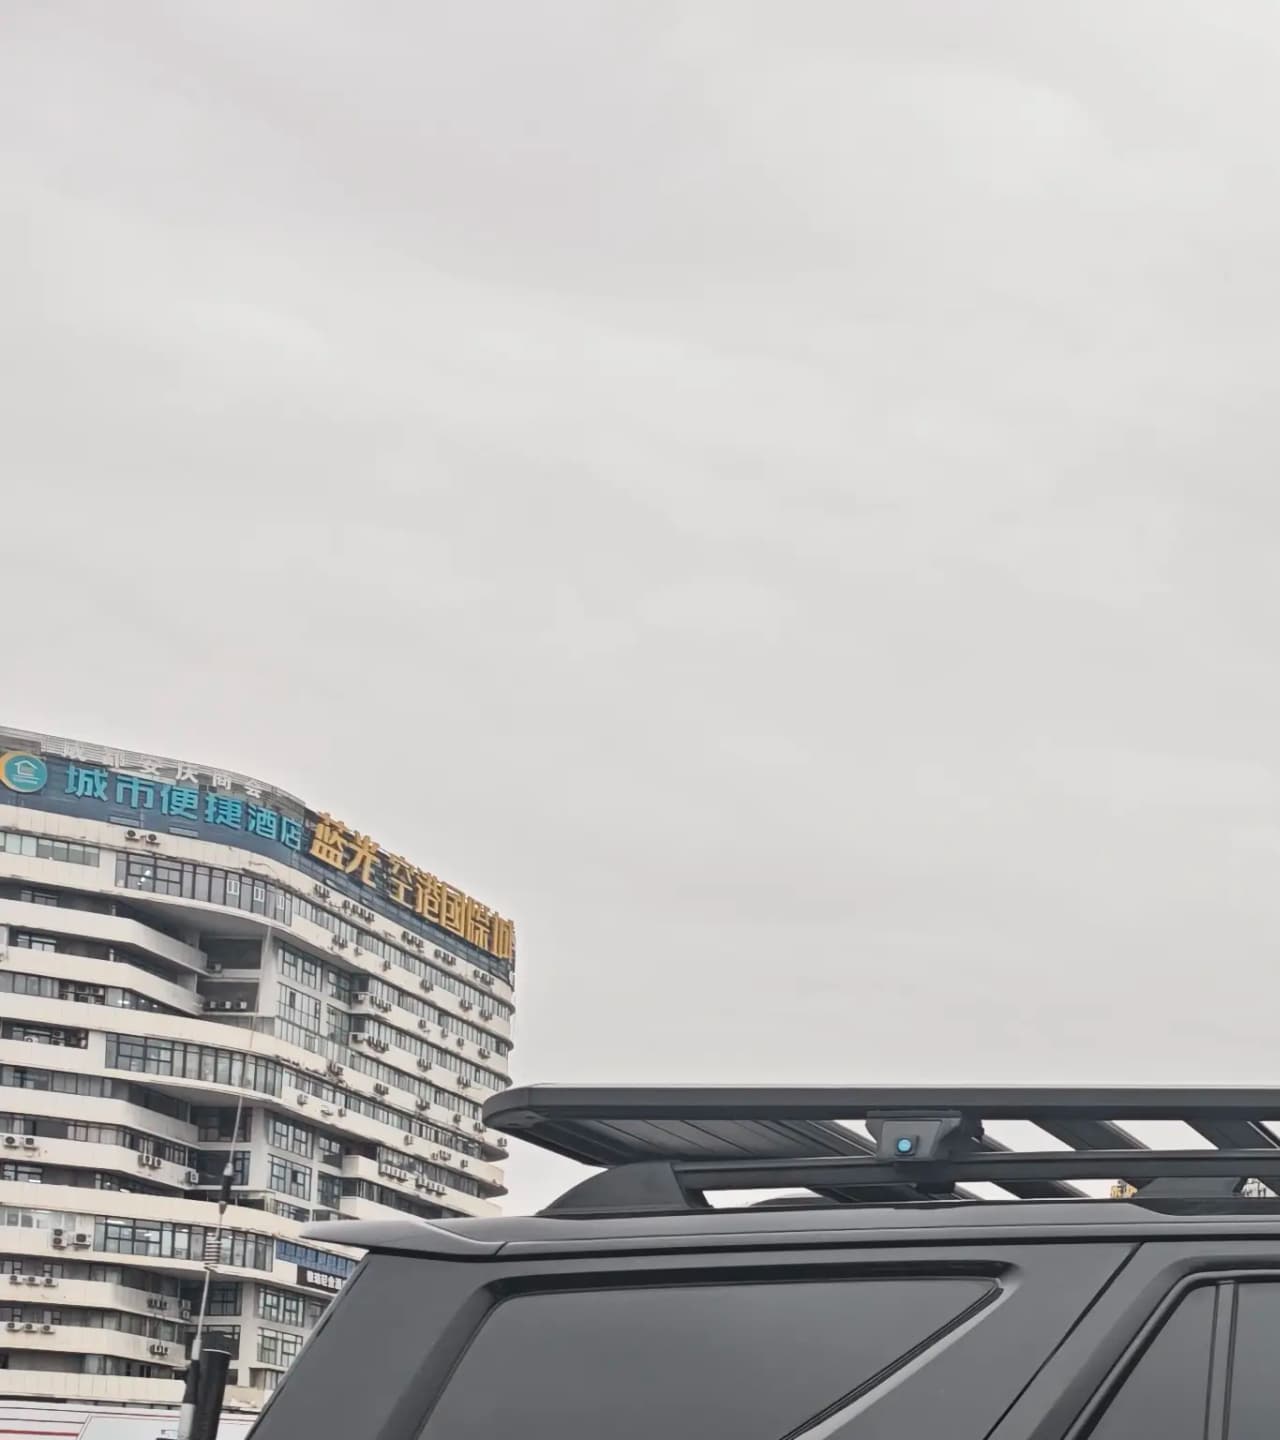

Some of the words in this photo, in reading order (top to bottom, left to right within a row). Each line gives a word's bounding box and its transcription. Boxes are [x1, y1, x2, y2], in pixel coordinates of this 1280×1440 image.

[64, 762, 304, 851] 城市便捷酒店
